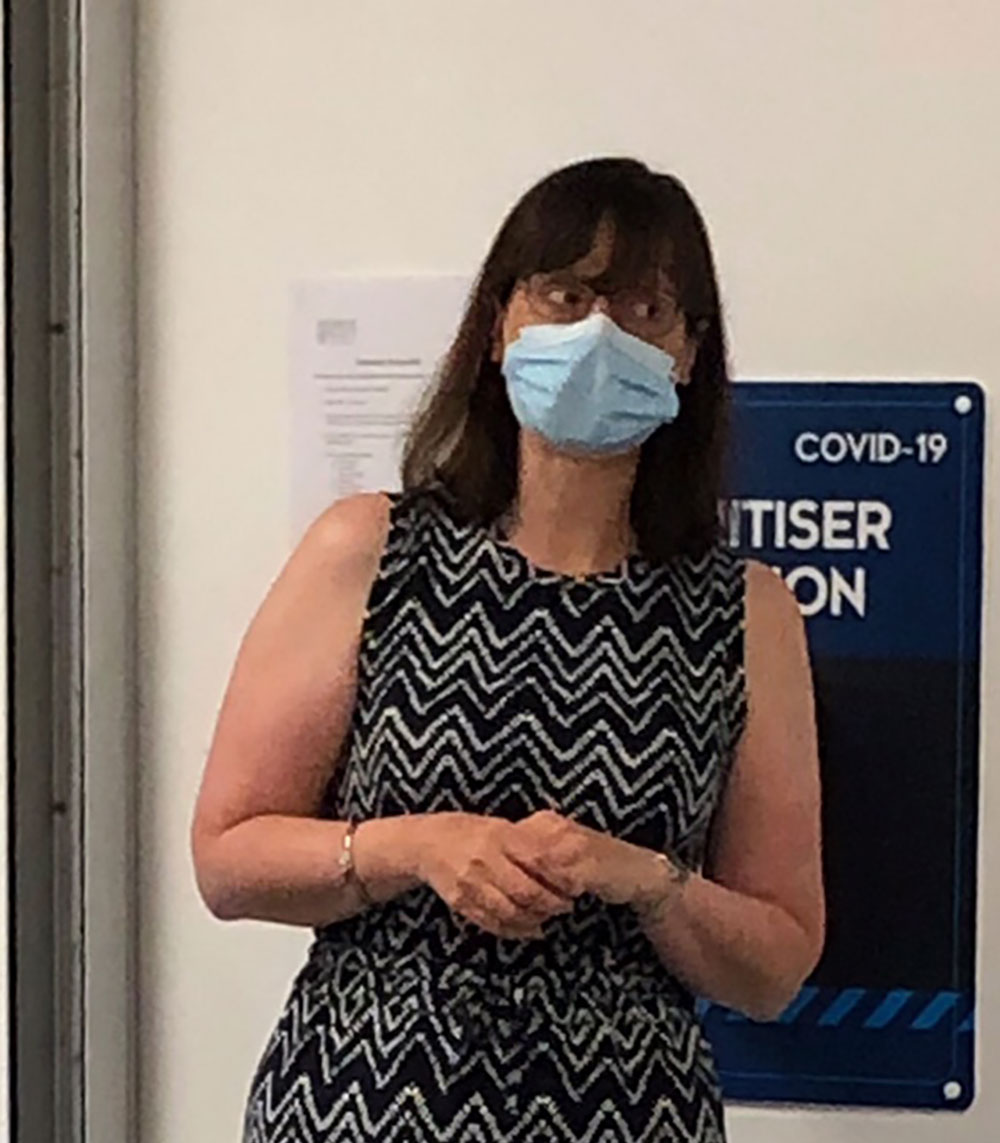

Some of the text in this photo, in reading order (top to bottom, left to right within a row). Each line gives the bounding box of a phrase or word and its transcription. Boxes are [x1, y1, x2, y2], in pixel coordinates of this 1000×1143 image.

[795, 431, 948, 464] COVID-19
[718, 499, 893, 551] ITISER
[772, 565, 867, 618] ON
